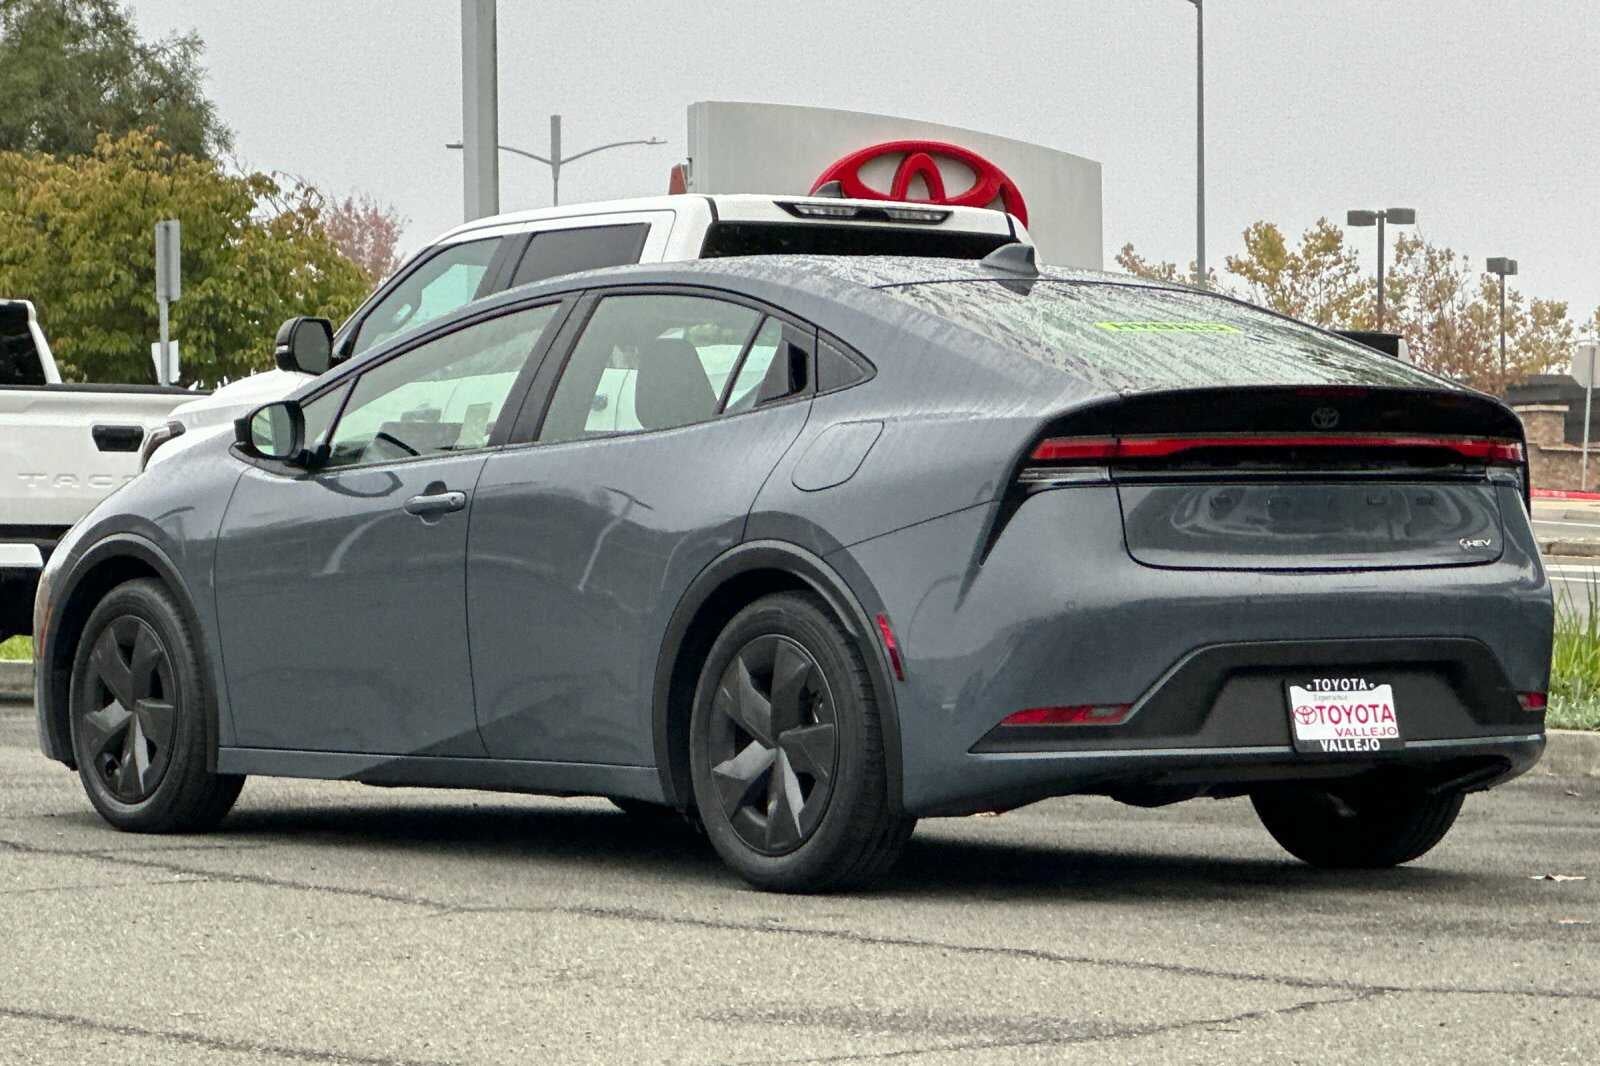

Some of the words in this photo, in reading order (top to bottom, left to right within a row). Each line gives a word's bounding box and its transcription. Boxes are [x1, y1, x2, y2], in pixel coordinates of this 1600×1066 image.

[17, 472, 137, 489] TAC
[1313, 678, 1368, 691] TOYOTA
[1315, 704, 1395, 725] TOYOTA
[1335, 726, 1398, 737] VALLEJO
[1320, 738, 1381, 752] VALLEJO
